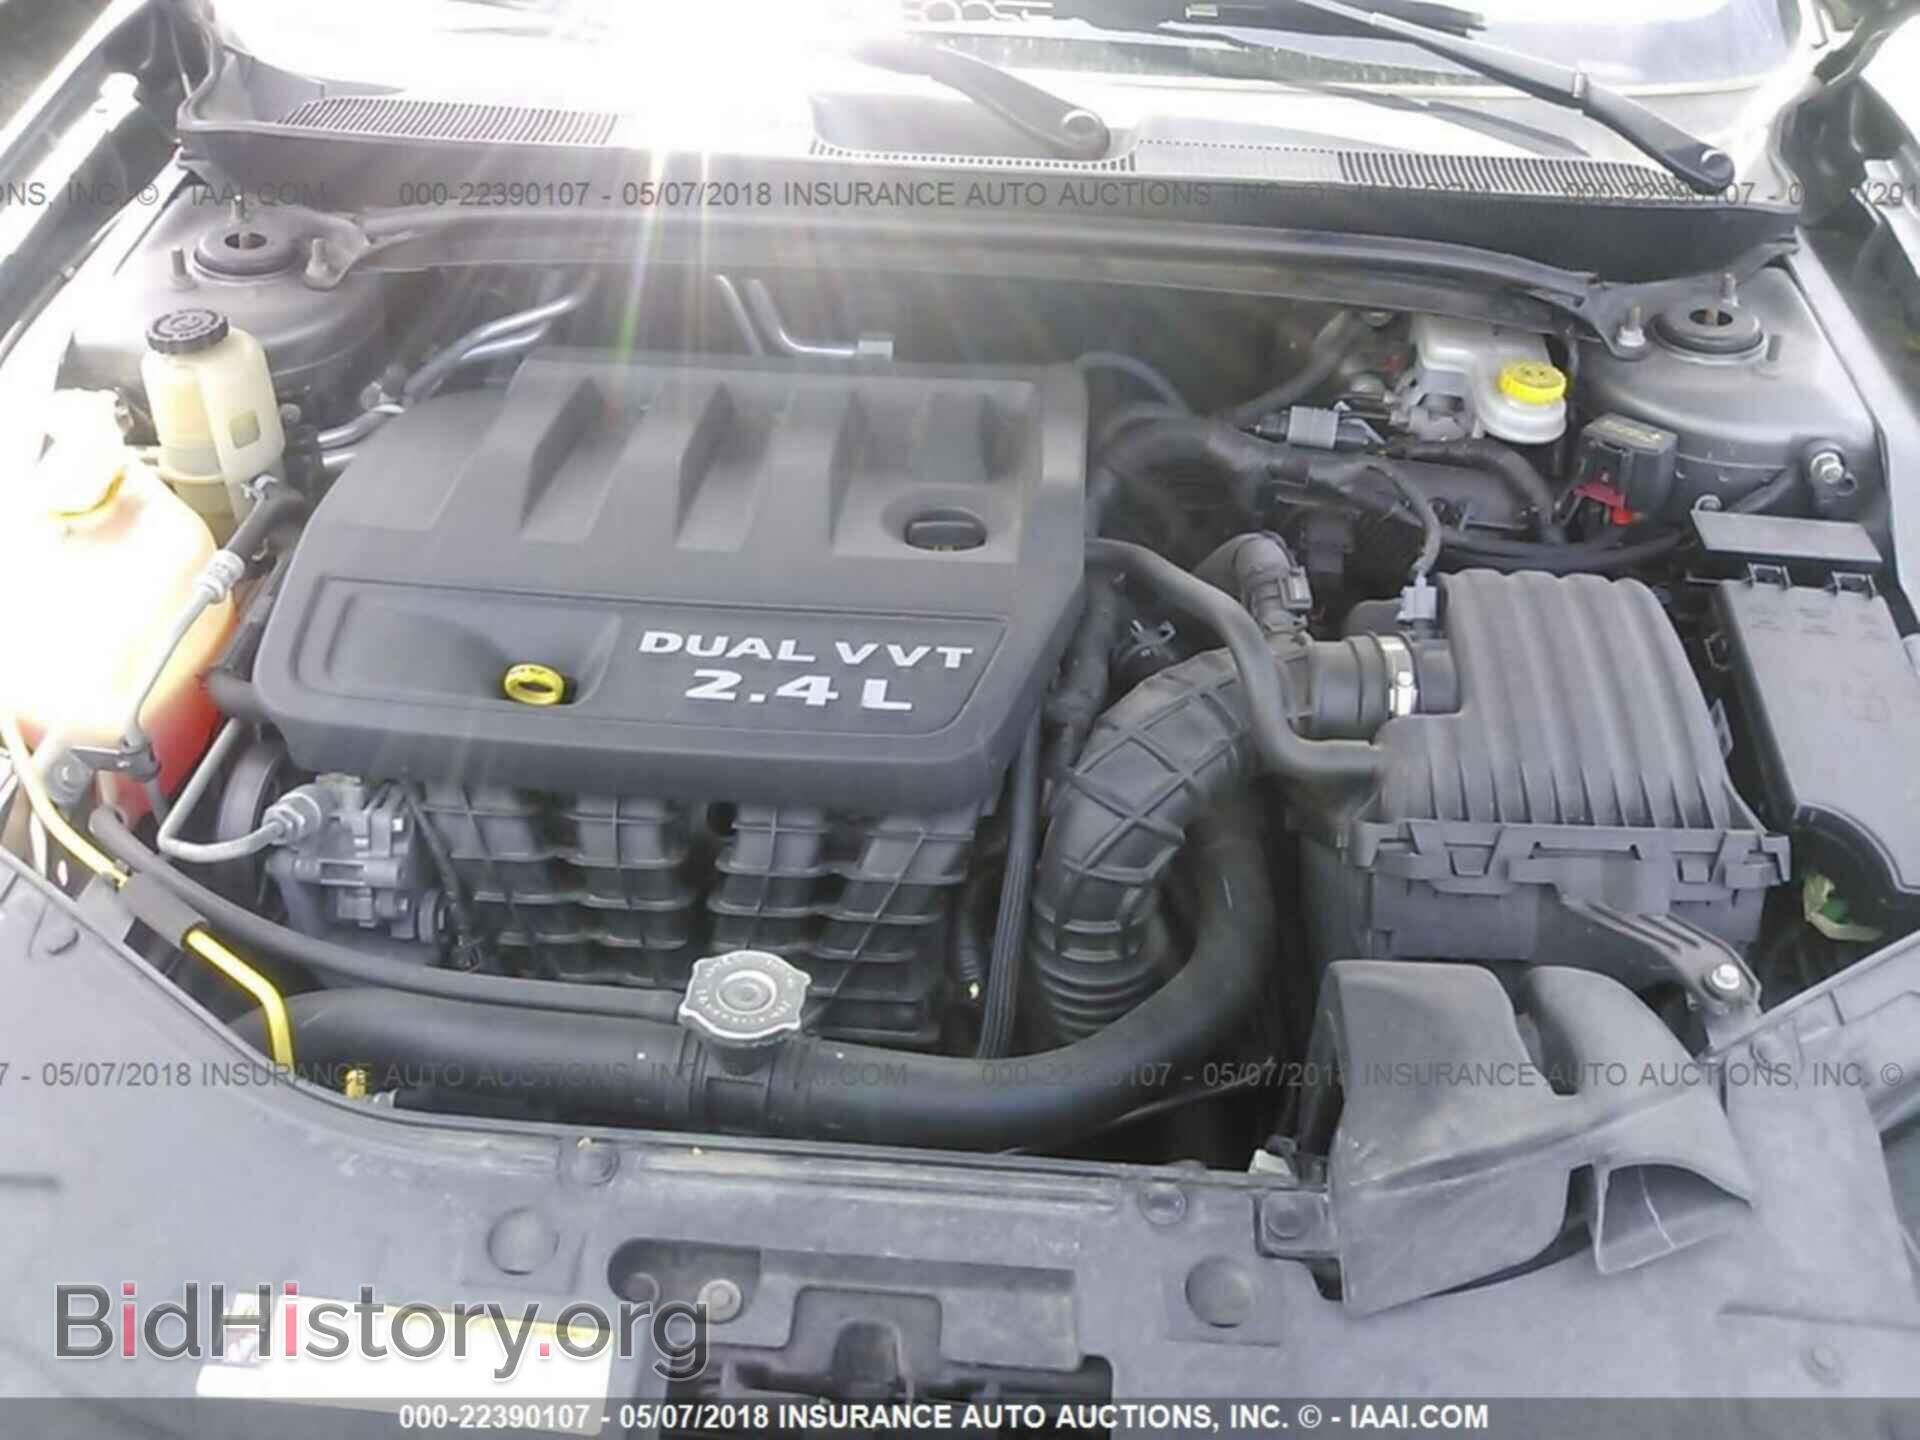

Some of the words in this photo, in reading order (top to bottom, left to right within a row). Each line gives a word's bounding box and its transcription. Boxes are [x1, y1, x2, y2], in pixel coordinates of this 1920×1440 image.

[638, 631, 816, 662] DUAL
[835, 641, 975, 668] VVT
[685, 669, 839, 706] 2.4
